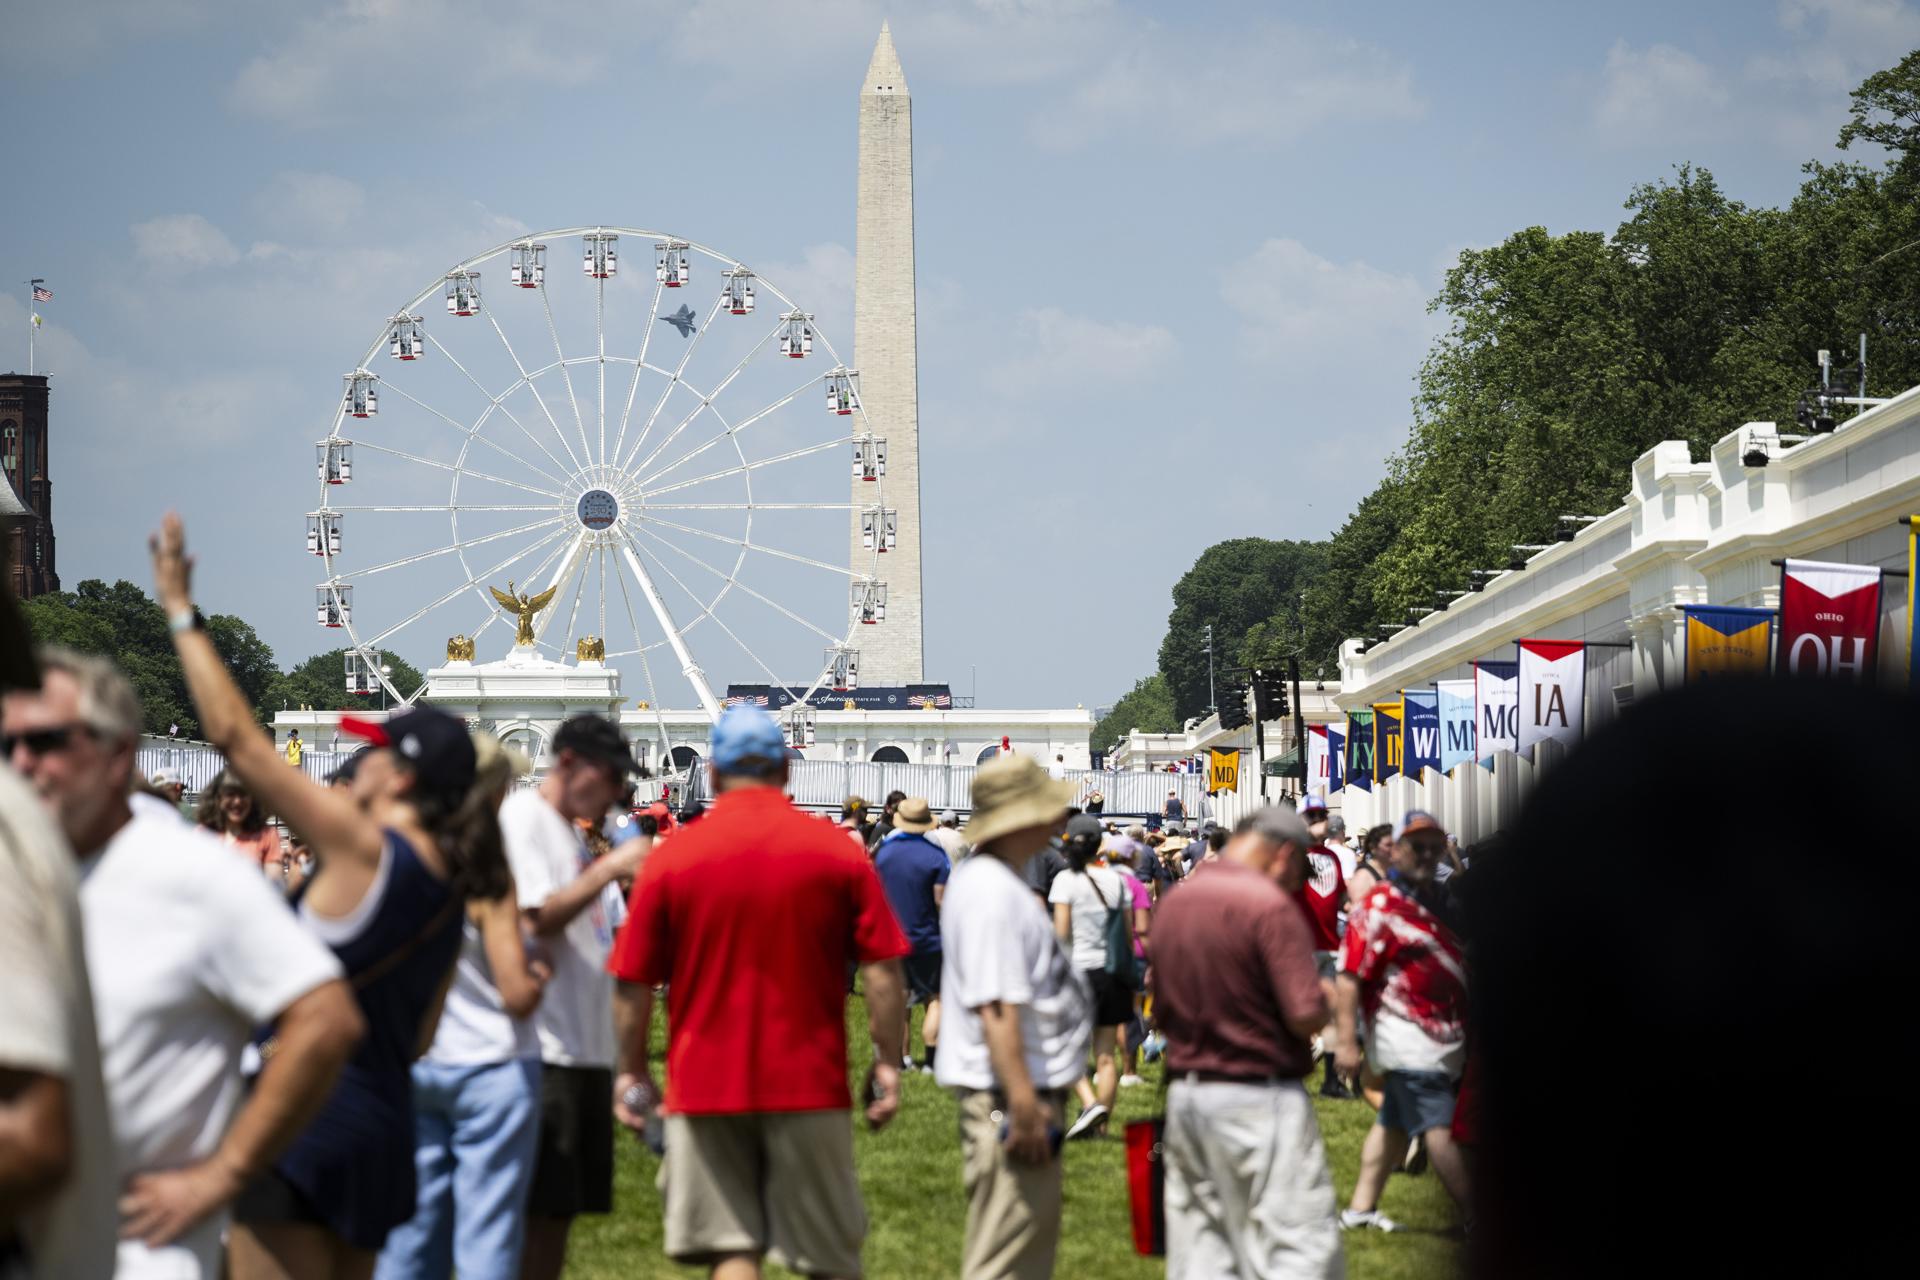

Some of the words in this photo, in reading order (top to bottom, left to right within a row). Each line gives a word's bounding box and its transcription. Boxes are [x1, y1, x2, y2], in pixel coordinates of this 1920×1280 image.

[1815, 612, 1844, 623] OHIO
[1789, 633, 1866, 677] OH
[1534, 683, 1569, 728] IA
[1352, 742, 1374, 769] KY
[1215, 766, 1235, 783] MD
